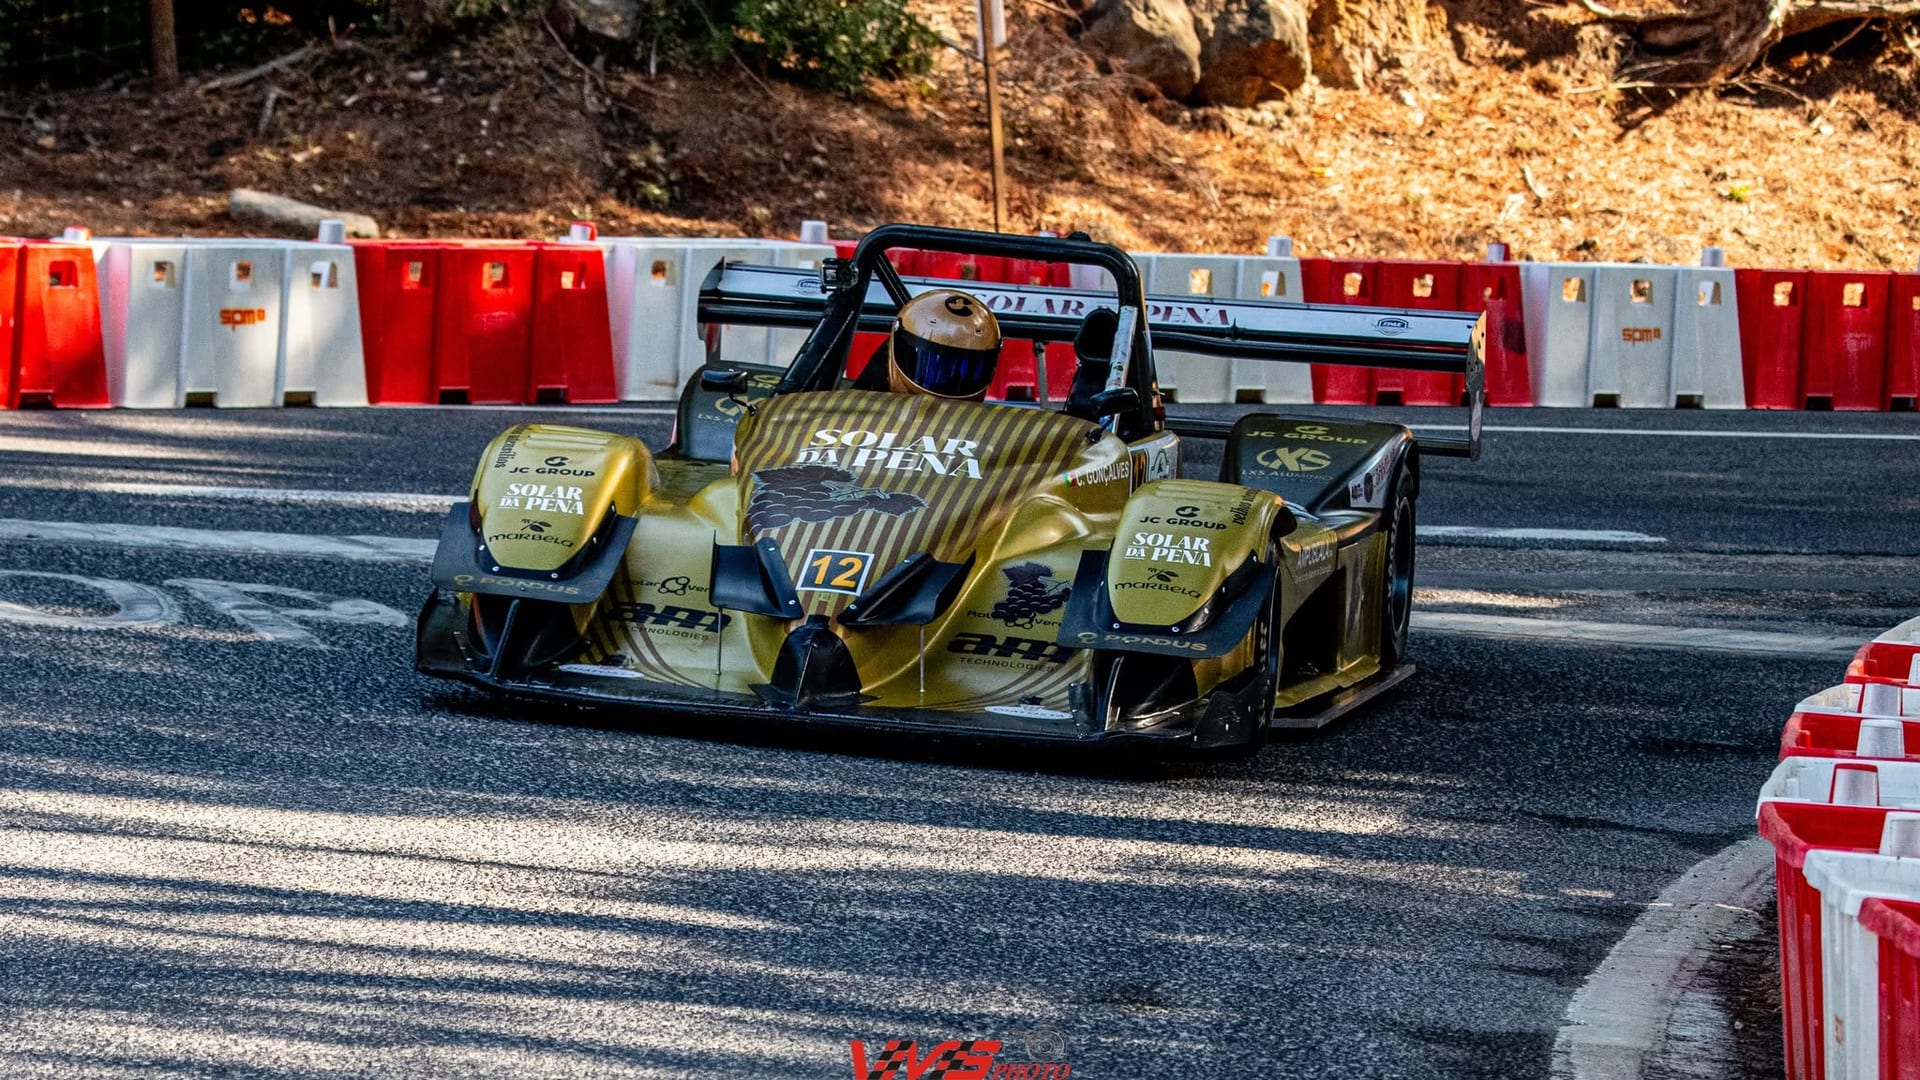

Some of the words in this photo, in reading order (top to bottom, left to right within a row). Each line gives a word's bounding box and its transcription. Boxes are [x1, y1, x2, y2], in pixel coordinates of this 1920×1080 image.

[973, 293, 1084, 315] OLAR
[810, 429, 977, 457] SOLAR
[1283, 433, 1369, 445] GROUP
[535, 467, 596, 477] GROUP
[795, 450, 839, 465] DA
[852, 448, 983, 480] PENA
[1086, 461, 1130, 486] GONÇALVES
[506, 483, 583, 501] SOLAR
[499, 497, 520, 507] DA
[524, 497, 584, 515] PENA
[1140, 516, 1161, 524] JC
[1166, 518, 1228, 530] GROUP
[1132, 532, 1210, 552] SOLAR
[1125, 547, 1146, 558] DA
[1151, 547, 1212, 567] PENA
[812, 555, 863, 588] 12
[1104, 634, 1209, 651] PONDUS
